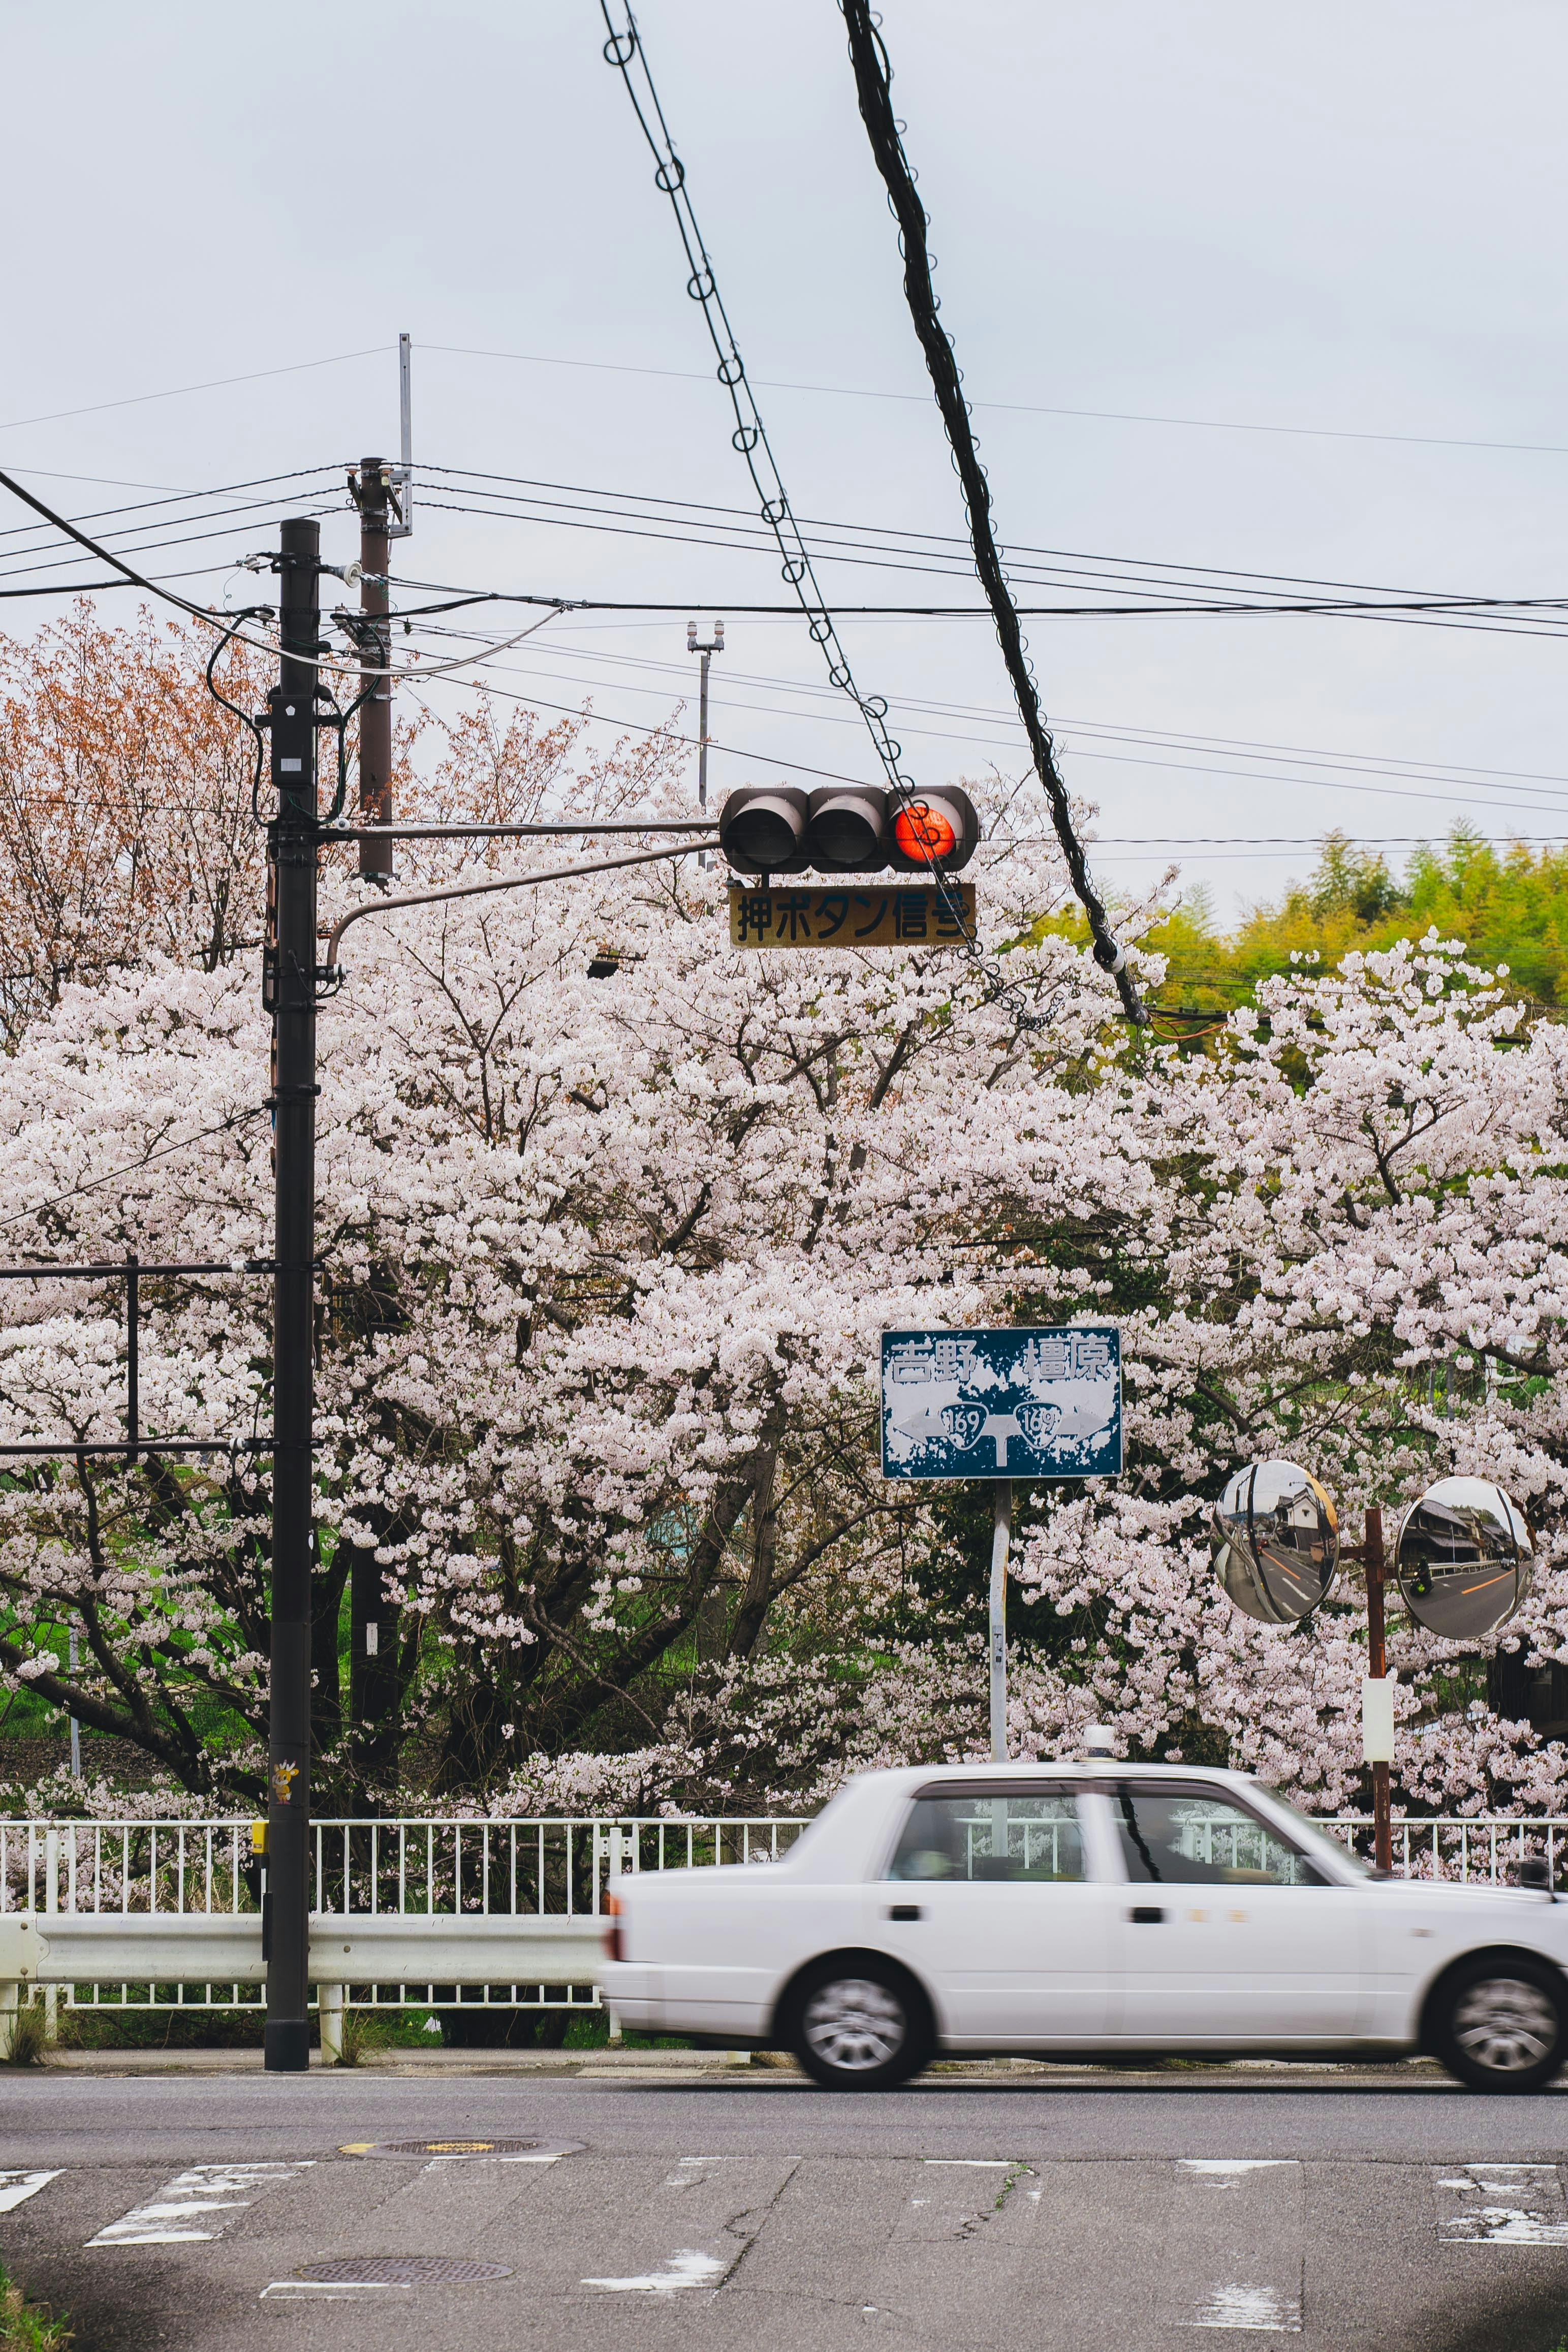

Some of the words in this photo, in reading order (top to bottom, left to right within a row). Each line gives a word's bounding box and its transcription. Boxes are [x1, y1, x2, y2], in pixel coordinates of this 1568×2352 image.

[737, 892, 964, 942] 押ボタン信号
[891, 1339, 977, 1382] 吉野
[1022, 1337, 1110, 1379] 橿原
[948, 1410, 980, 1433] 169
[1023, 1409, 1056, 1432] 169
